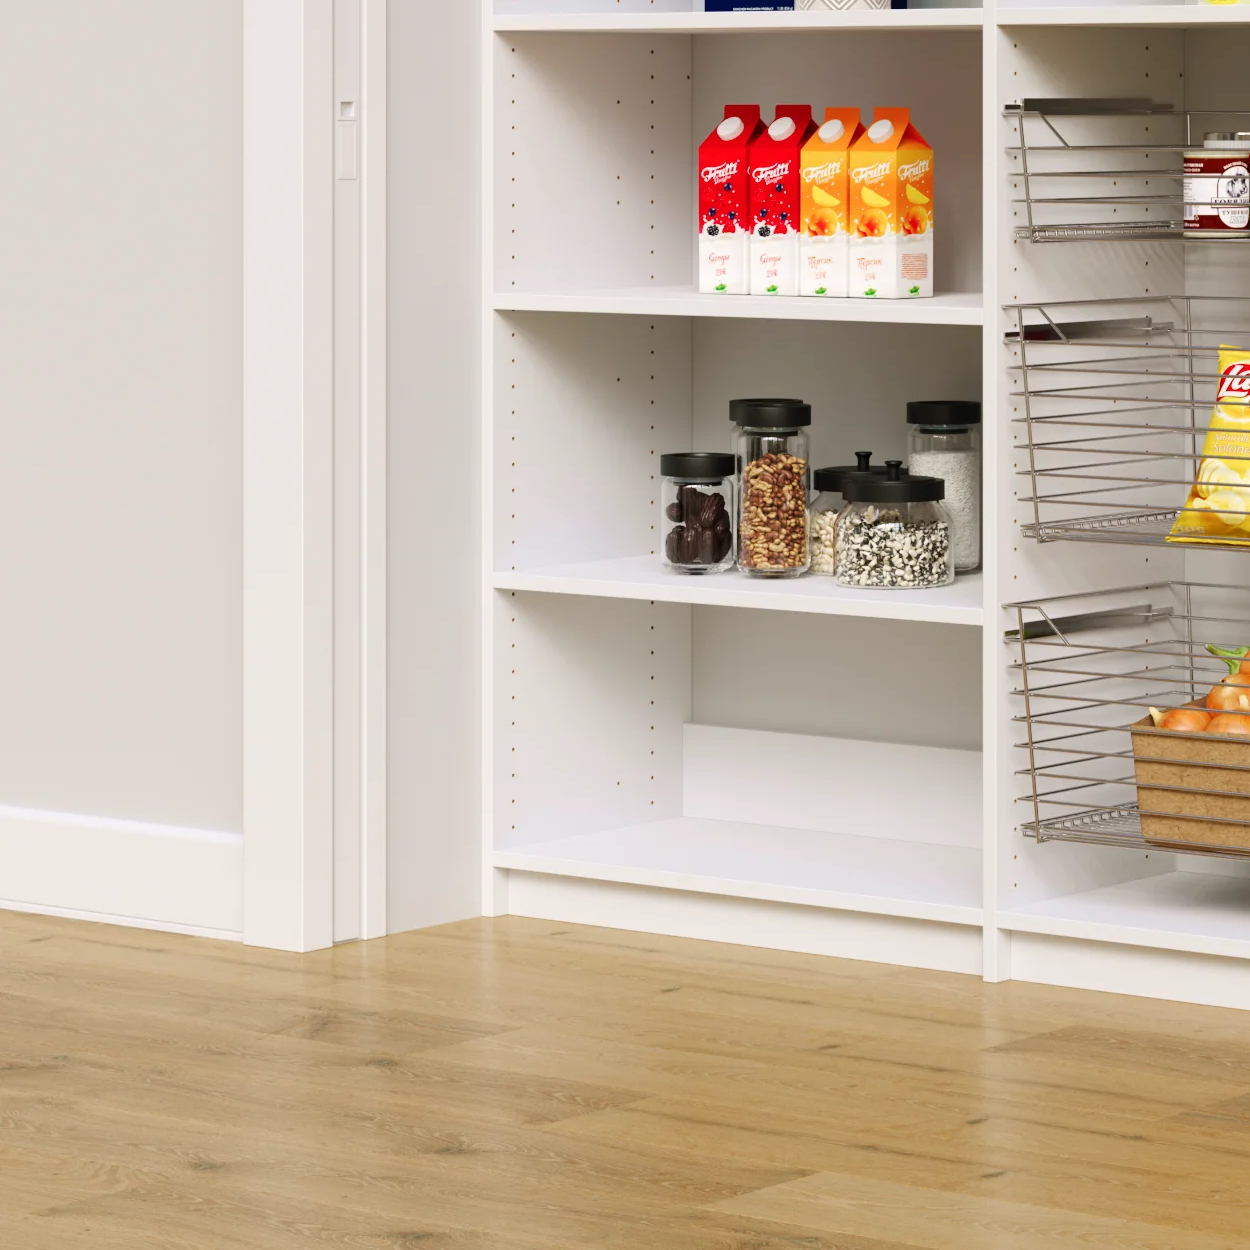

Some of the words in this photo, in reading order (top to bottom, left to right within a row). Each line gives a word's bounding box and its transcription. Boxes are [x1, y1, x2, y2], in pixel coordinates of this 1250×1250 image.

[701, 162, 738, 182] Frutti
[752, 163, 790, 183] Frutti
[802, 160, 841, 182] Frutti
[852, 161, 891, 183] Frutti
[898, 159, 930, 180] Frutti
